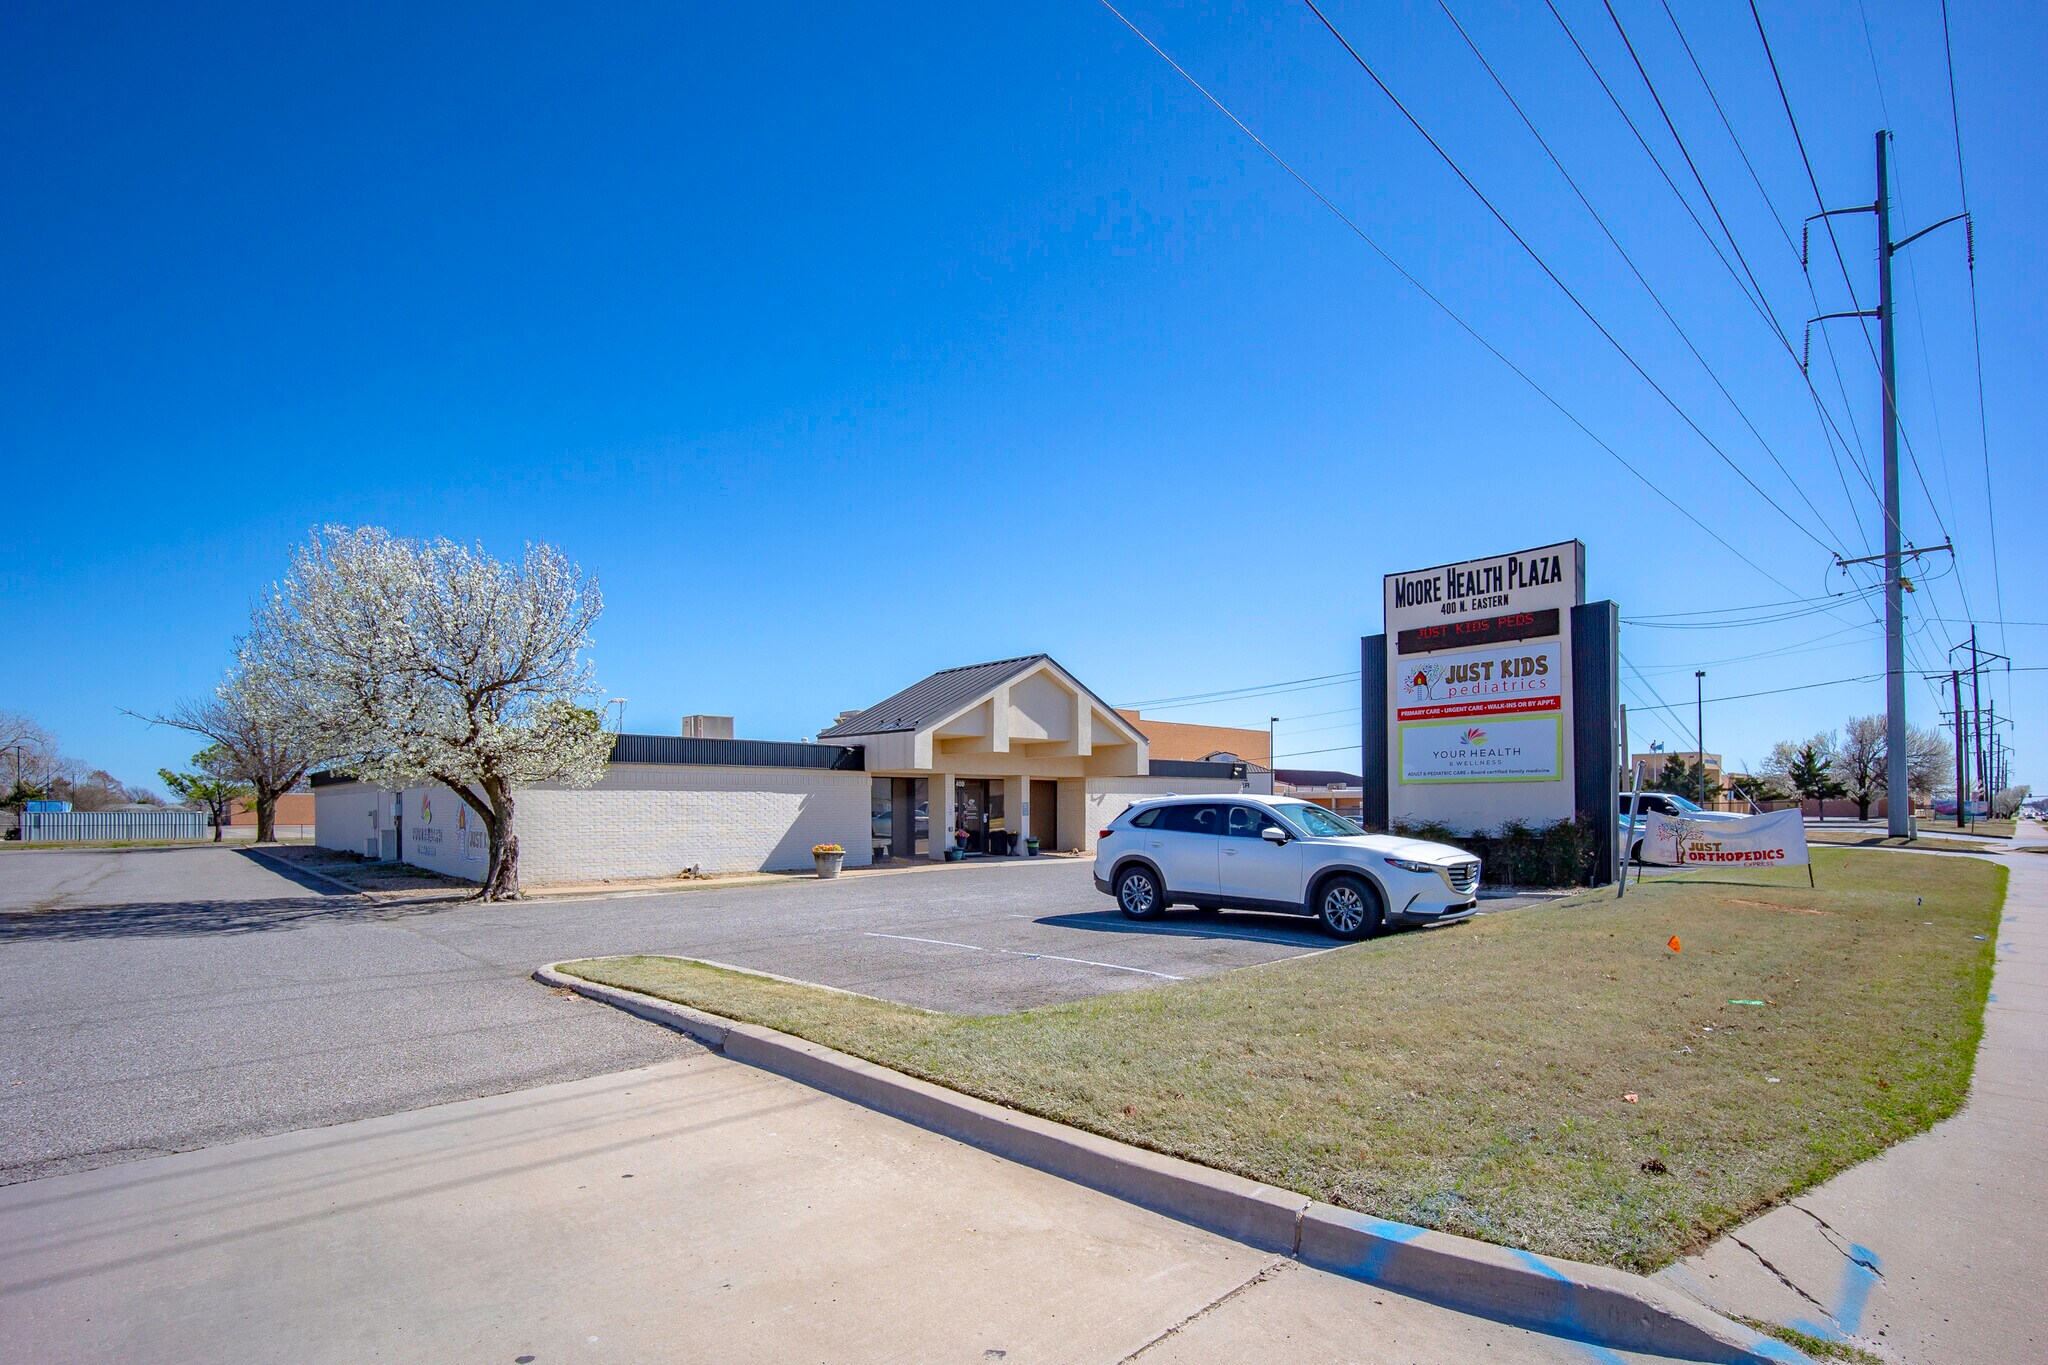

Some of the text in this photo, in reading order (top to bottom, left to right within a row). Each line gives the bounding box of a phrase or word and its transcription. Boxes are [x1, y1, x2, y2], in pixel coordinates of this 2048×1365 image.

[1395, 555, 1562, 608] MOORE HEALTH PLAZA
[1441, 594, 1509, 615] 400 N. EASTERN
[1417, 612, 1534, 639] JUST KIDS PEDS
[1445, 655, 1548, 684] JUST KIDS
[1449, 678, 1547, 699] pediatrics
[1433, 748, 1520, 759] YOUR HEALTH
[1688, 842, 1722, 852] JUST
[1689, 849, 1784, 861] ORTHOPEDICS
